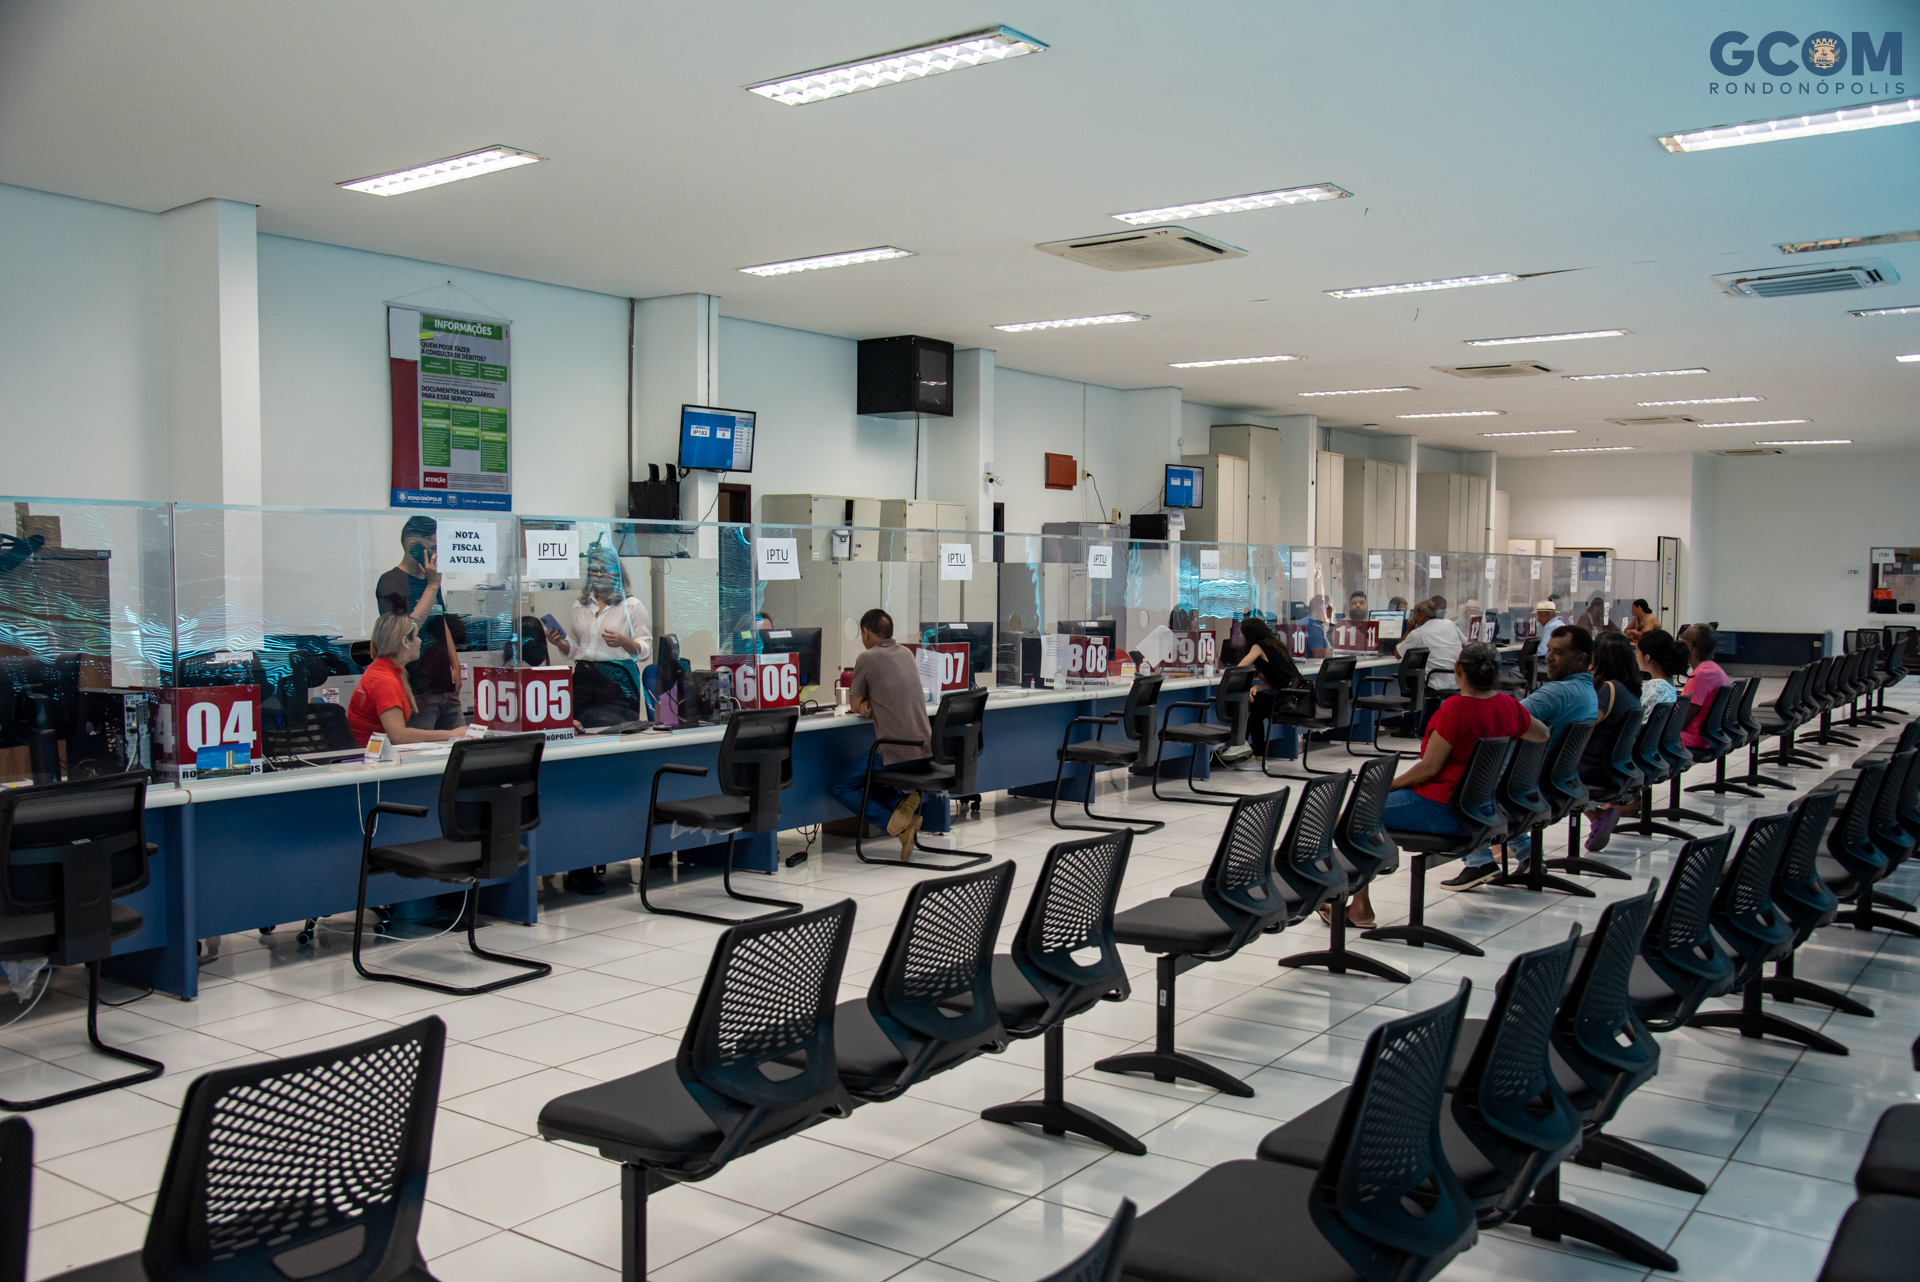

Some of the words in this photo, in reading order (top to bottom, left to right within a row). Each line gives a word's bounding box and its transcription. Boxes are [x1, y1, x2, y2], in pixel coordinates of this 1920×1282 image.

[434, 319, 492, 336] INFORMAÇÕES
[421, 341, 438, 349] QUEM
[438, 343, 454, 351] PODE
[425, 349, 454, 358] CONSULTA
[461, 352, 486, 362] DÉBITOS?
[421, 386, 460, 395] DOCUMENTOS
[460, 388, 495, 399] NECESSÁRIOS
[450, 395, 473, 404] SERVIÇO
[424, 476, 446, 484] ATENÇÃO
[455, 531, 480, 539] NOTA
[452, 544, 483, 552] FISCAL
[538, 542, 567, 557] IPTU
[767, 548, 789, 561] IPTU
[449, 556, 486, 564] AVULSA
[947, 553, 966, 564] IPTU
[1093, 554, 1107, 564] IPTU
[1336, 625, 1357, 647] 11
[1367, 626, 1376, 648] 11
[1470, 621, 1480, 640] 12
[1292, 631, 1306, 654] 10
[1198, 637, 1215, 664] 09
[1086, 645, 1107, 673] 08
[942, 652, 965, 685] 07
[762, 663, 798, 702] 06
[477, 679, 518, 723] 05
[525, 679, 571, 723] 05
[187, 700, 257, 753] 04
[546, 732, 574, 741] NÓPOLIS
